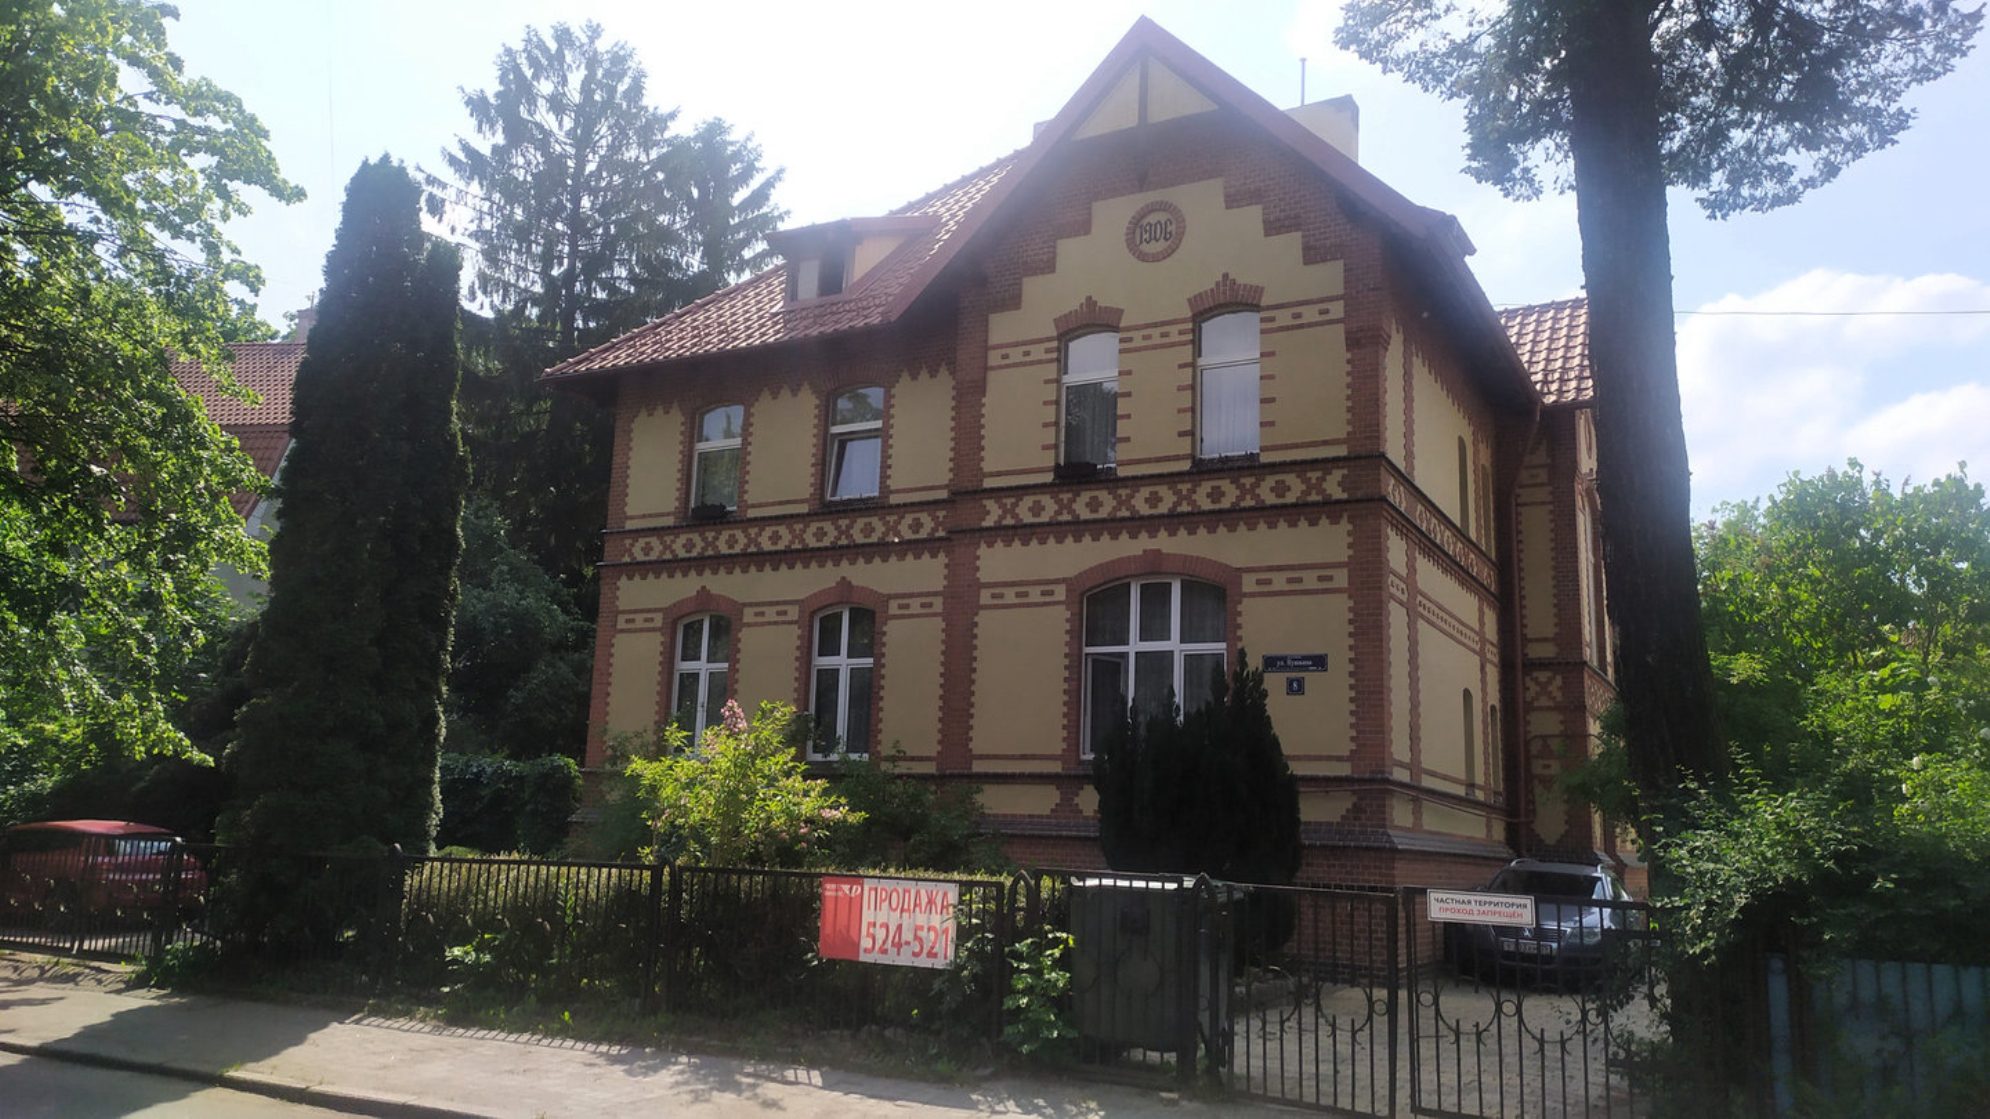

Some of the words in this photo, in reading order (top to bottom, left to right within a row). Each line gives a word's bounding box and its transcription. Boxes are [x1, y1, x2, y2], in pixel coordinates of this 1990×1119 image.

[1137, 218, 1173, 246] 1906
[867, 885, 951, 918] ПРОДАЖА
[1433, 896, 1472, 906] ЧАСТНАЯ
[1474, 899, 1528, 909] ТЕРРИТОРИЯ
[1439, 906, 1474, 916] ПРОХОД
[863, 920, 951, 960] 524-521
